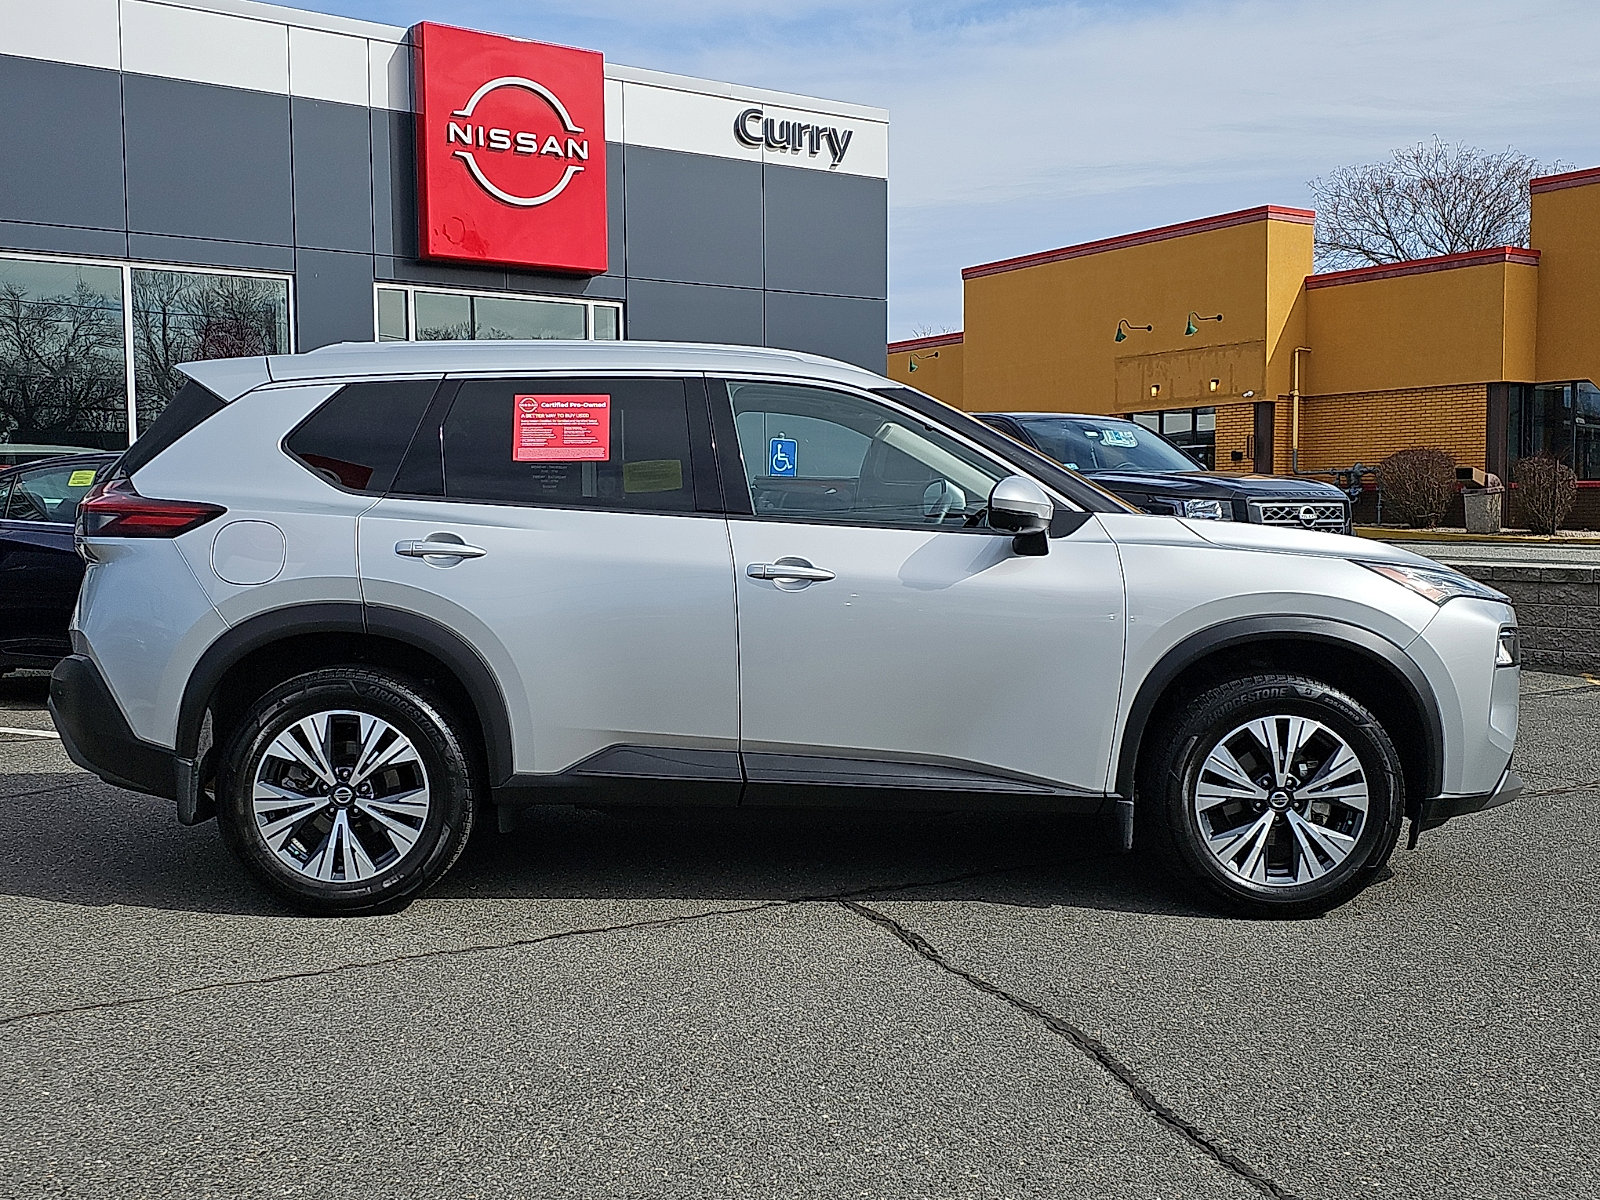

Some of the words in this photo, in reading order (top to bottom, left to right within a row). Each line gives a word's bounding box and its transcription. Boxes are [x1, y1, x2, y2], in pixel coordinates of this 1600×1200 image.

[447, 121, 589, 160] NISSAN
[734, 108, 853, 168] Curry
[1203, 687, 1288, 724] BRIDGESTONE
